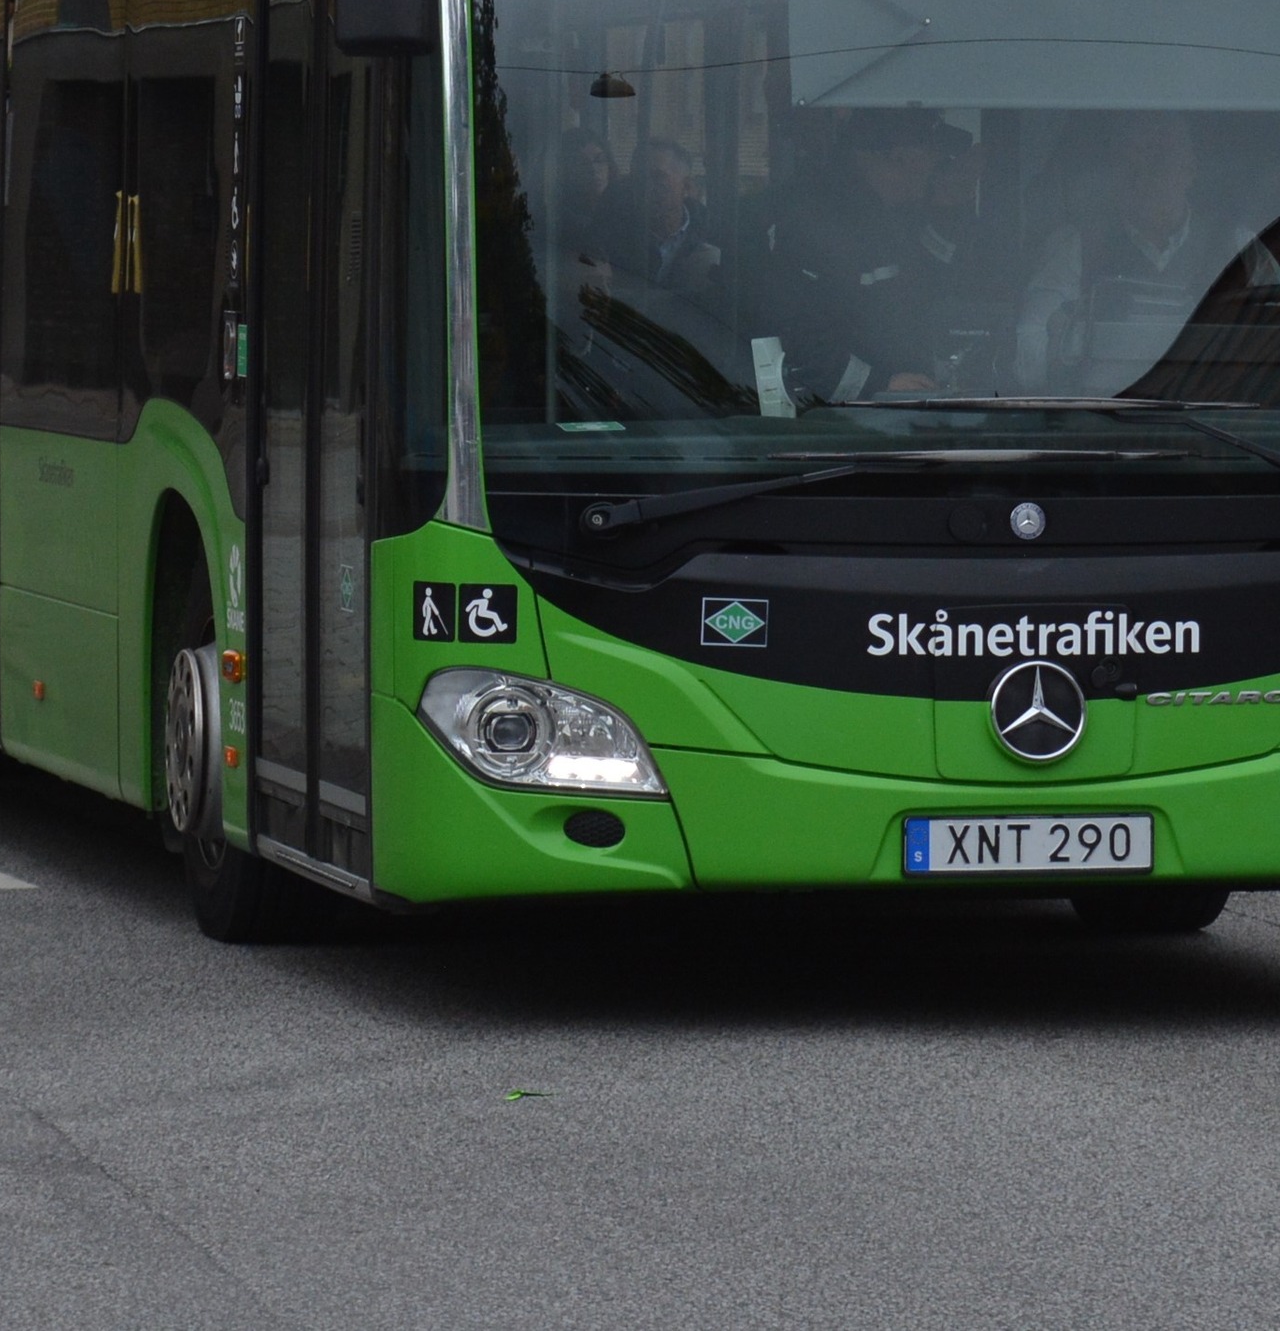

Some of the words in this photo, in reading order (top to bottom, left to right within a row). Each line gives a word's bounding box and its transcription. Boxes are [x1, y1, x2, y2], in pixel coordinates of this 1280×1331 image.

[715, 614, 755, 630] CNG
[866, 609, 1201, 657] Skånetrafiken
[913, 851, 923, 862] S
[946, 823, 1031, 864] XNT
[1048, 822, 1132, 863] 290
